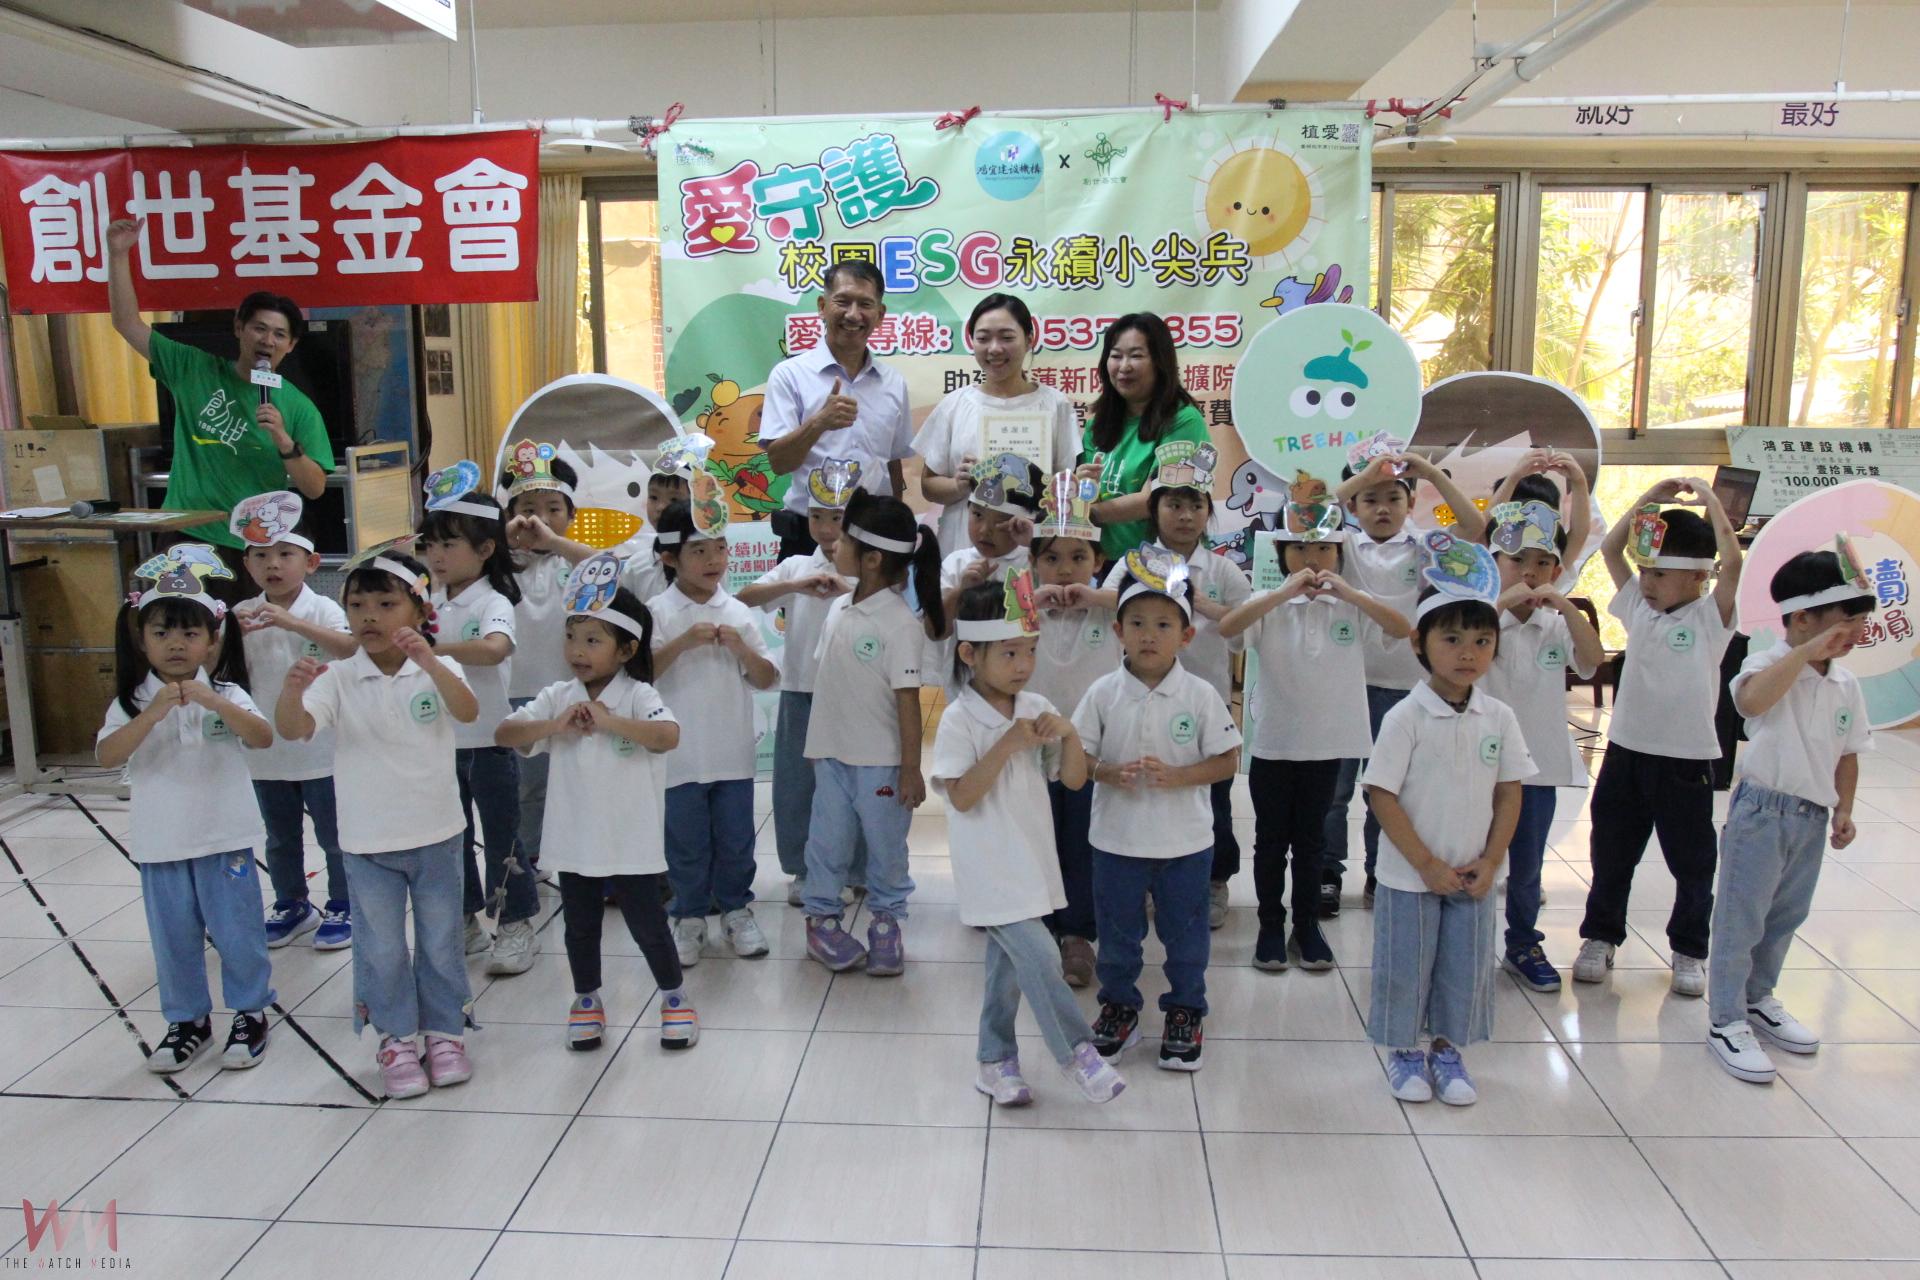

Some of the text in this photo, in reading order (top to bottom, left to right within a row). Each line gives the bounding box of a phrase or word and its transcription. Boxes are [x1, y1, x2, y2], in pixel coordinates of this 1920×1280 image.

[1781, 102, 1839, 127] 最好
[1301, 124, 1339, 140] 植愛
[681, 133, 940, 258] 愛守護
[20, 157, 528, 284] 創世基金會
[788, 314, 952, 351] 愛專線:
[1273, 430, 1375, 453] TREEHA
[1762, 440, 1872, 453] 鴻宜建設機構
